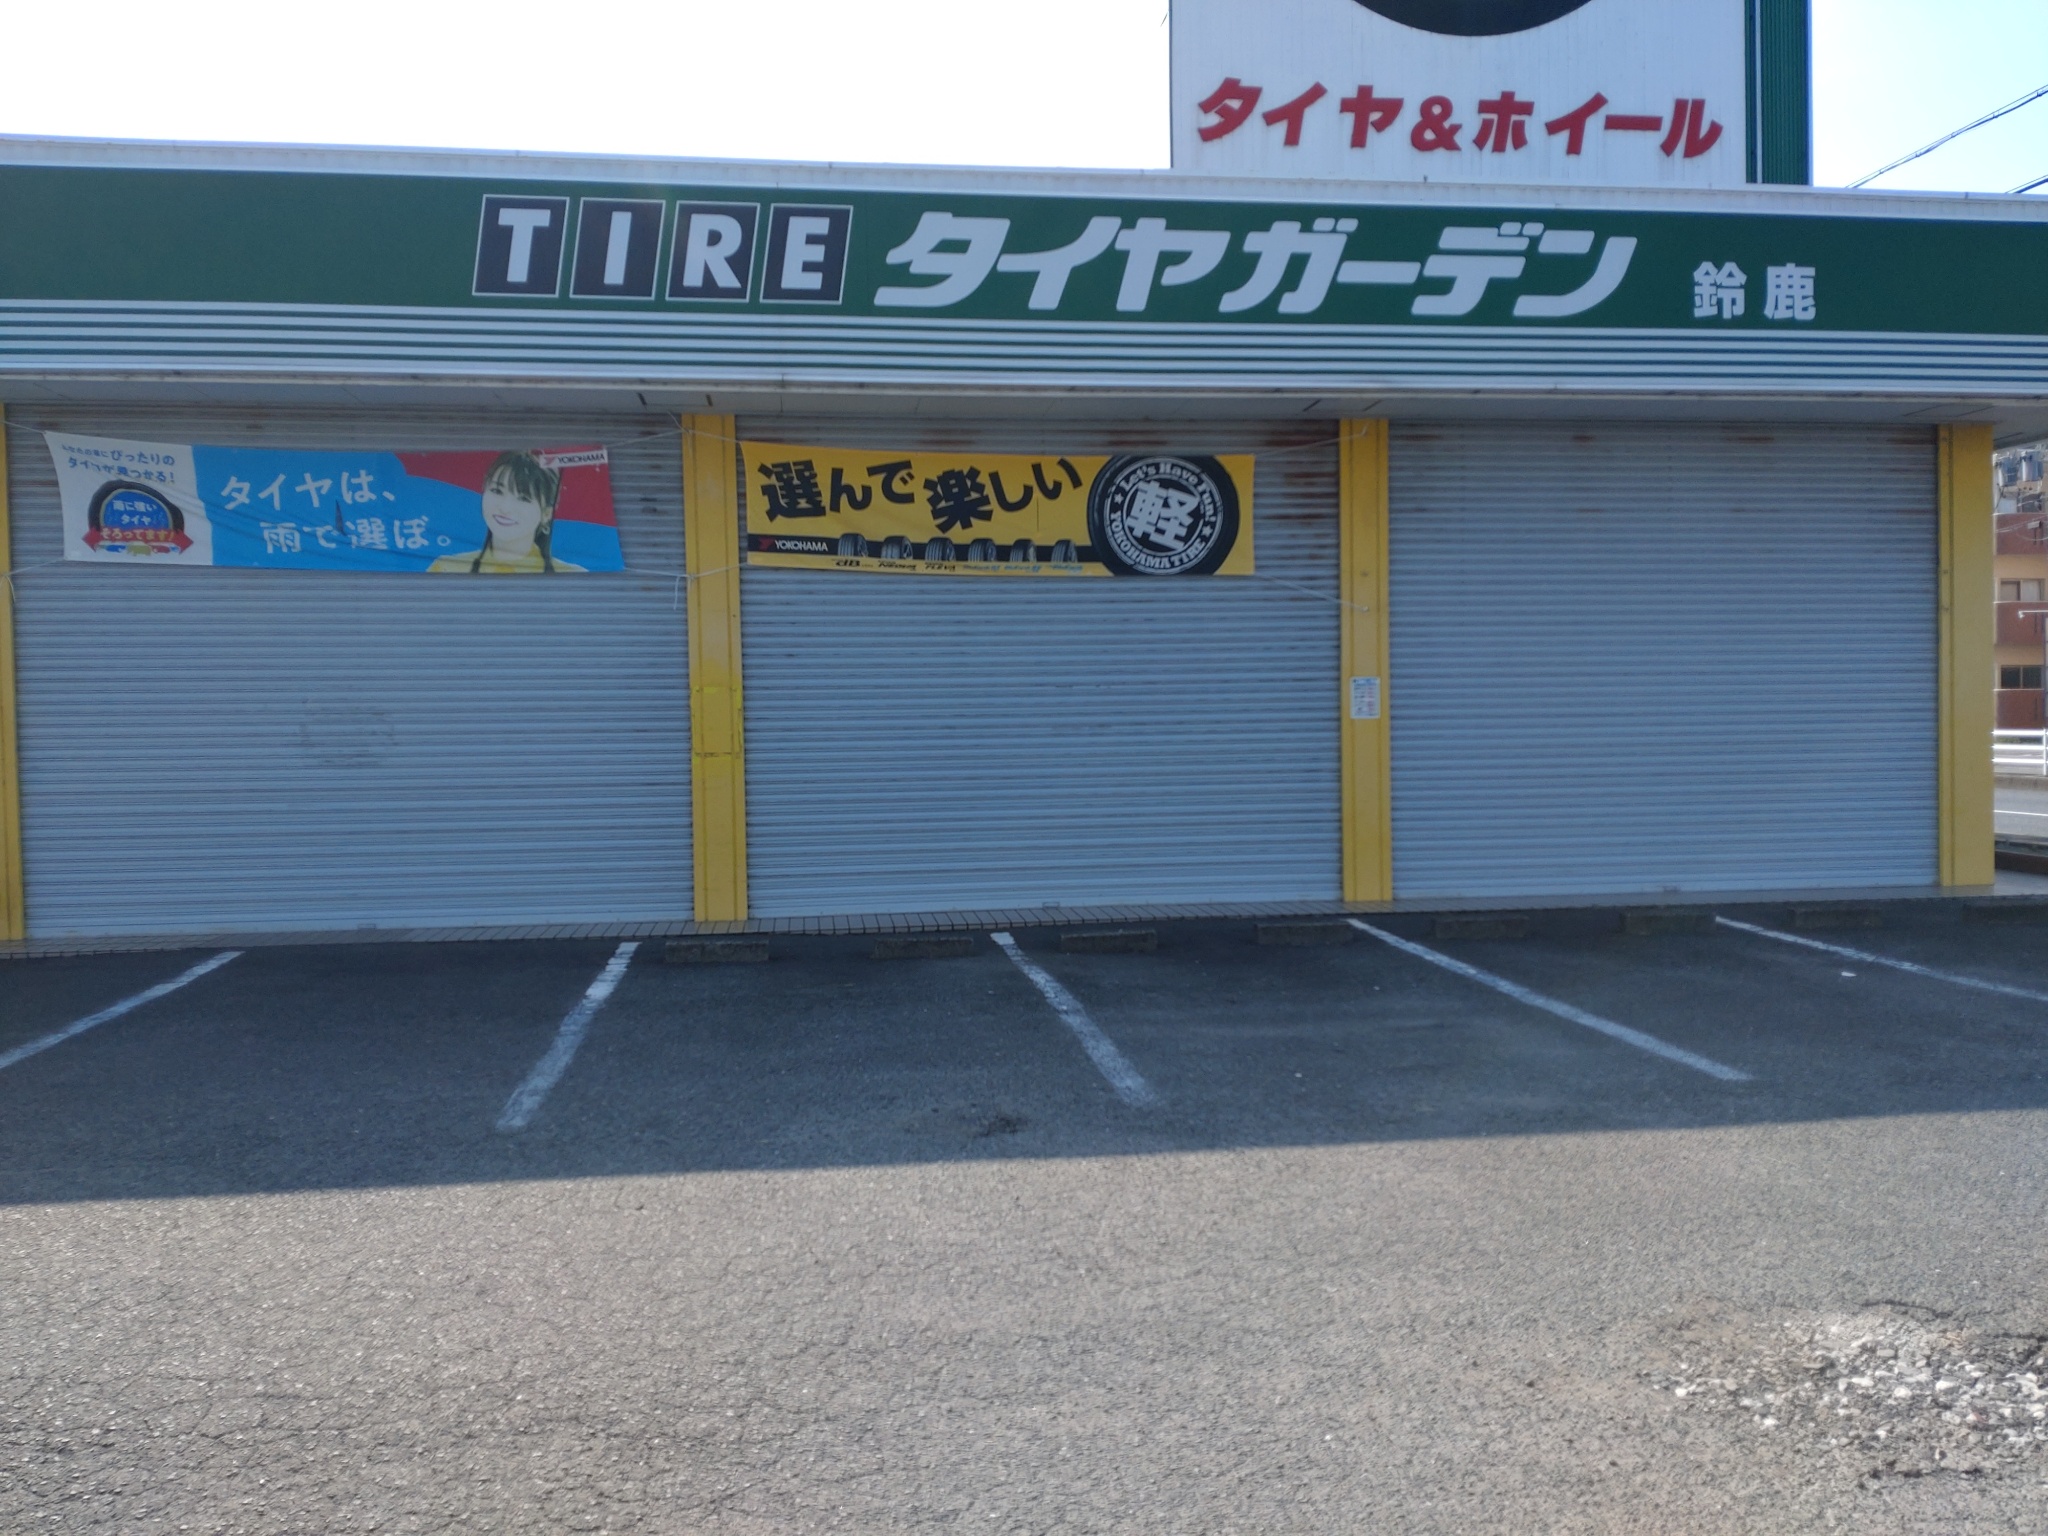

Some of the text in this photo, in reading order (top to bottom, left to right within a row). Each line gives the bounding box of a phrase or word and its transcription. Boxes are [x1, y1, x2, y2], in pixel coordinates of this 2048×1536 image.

[1198, 77, 1724, 159] タイヤ&ホイール
[498, 207, 1817, 321] TIRE タイヤガーデン 鈴鹿
[558, 453, 605, 464] YOKOHAMA
[121, 514, 152, 526] タイヤ
[220, 469, 396, 512] タイヤは、
[757, 457, 1083, 534] 選んで楽しい
[1120, 462, 1217, 523] Let's Have Fun!
[1125, 479, 1200, 551] 軽
[259, 514, 452, 554] 雨で選ぼ。
[774, 540, 829, 552] YOKOHAMA
[1110, 510, 1206, 569] YOKOHAMA TIRE
